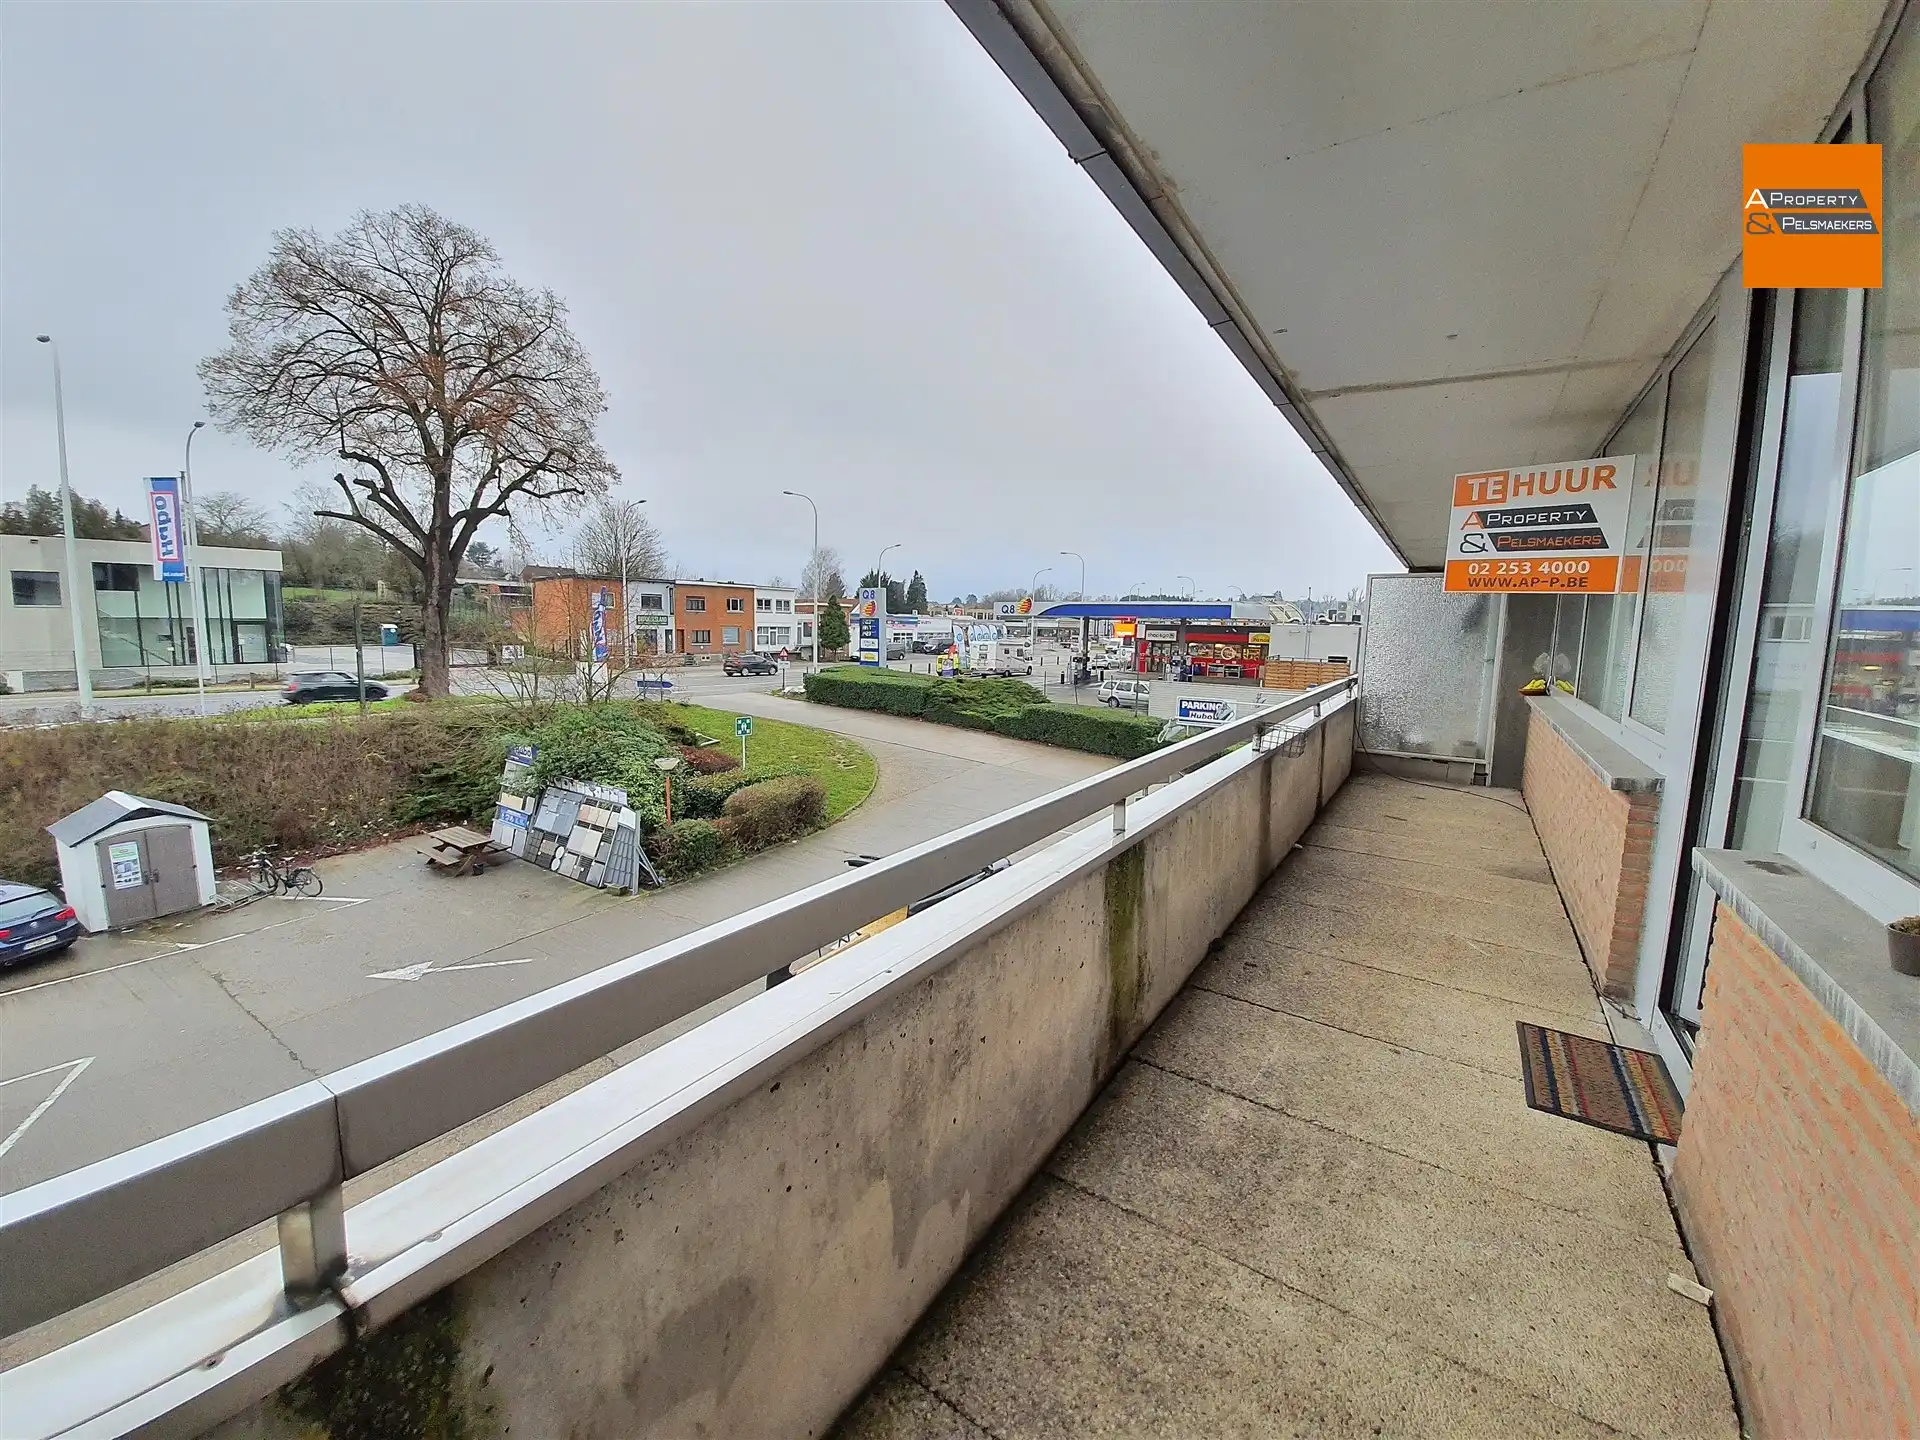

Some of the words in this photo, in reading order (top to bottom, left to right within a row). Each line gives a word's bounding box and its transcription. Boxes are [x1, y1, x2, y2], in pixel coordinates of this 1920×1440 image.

[1468, 476, 1504, 501] TE
[1512, 464, 1617, 497] HUUR
[1460, 511, 1485, 530] A
[1486, 509, 1588, 525] PROPERTY
[1459, 533, 1488, 553] &
[1496, 534, 1602, 549] PELSMAEKERS
[1468, 562, 1490, 575] 02
[1496, 561, 1531, 575] 253
[1538, 560, 1591, 575] 4000
[1468, 577, 1588, 589] WWW.AP-P.BE
[862, 589, 875, 600] Q8
[1001, 604, 1015, 614] Q8
[1190, 712, 1212, 720] Hubo
